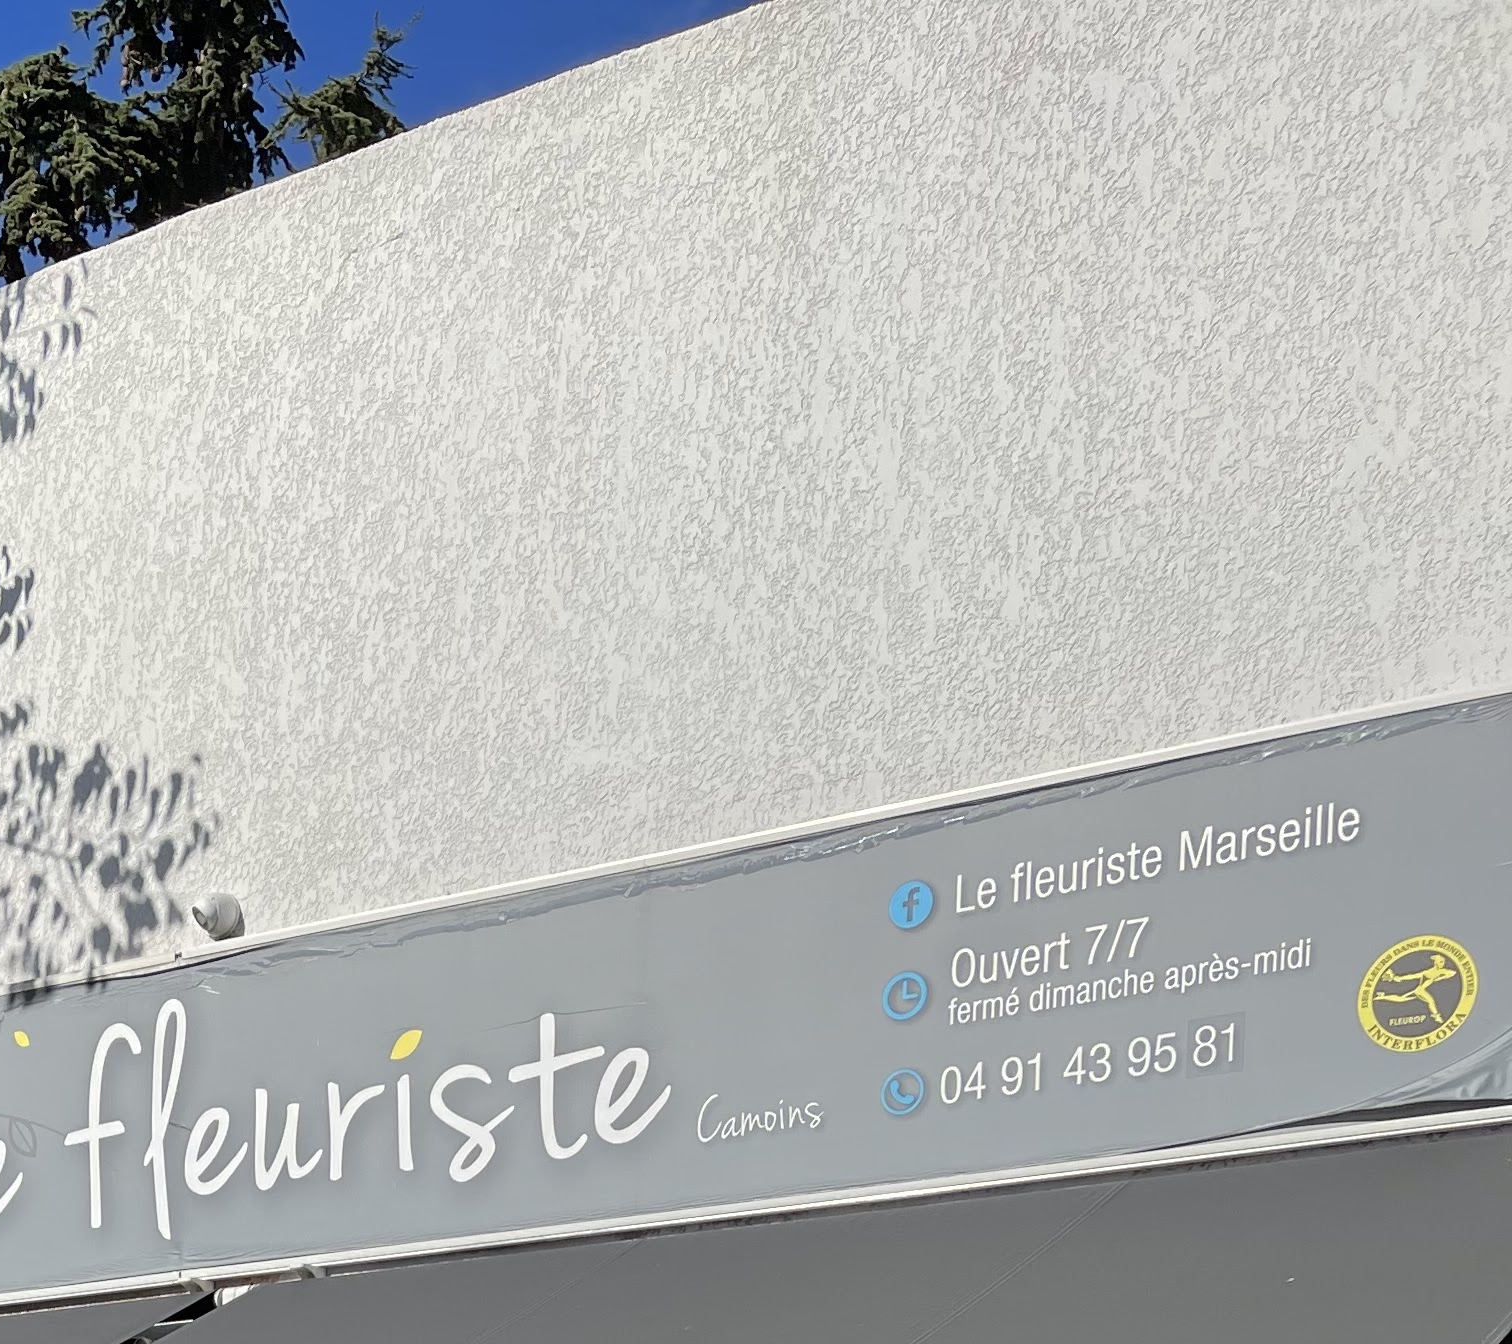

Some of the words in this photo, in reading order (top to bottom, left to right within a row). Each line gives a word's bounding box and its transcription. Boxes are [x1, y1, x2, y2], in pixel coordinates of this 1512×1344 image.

[954, 872, 997, 913] Le
[1011, 842, 1163, 900] fleuriste
[1179, 802, 1361, 872] Marseille
[948, 984, 1020, 1026] fermé
[1028, 966, 1156, 1012] dimanche
[1164, 938, 1314, 995] après-midi
[951, 932, 1070, 989] Ouvert
[1087, 916, 1151, 966] 7/7
[1361, 989, 1369, 1008] DES
[1365, 954, 1393, 989] FLEURS
[1393, 940, 1420, 957] DANS
[1422, 939, 1435, 947] LE
[1436, 940, 1467, 963] MONDE
[1462, 961, 1475, 996] ENTIER
[1368, 1012, 1467, 1050] INTERFLORA
[1389, 1015, 1426, 1026] FLEUROP
[939, 1063, 987, 1105] 04
[1000, 1053, 1044, 1095] 91
[1063, 1044, 1113, 1086] 43
[1127, 1032, 1177, 1076] 95
[1192, 1022, 1238, 1069] 81
[64, 998, 672, 1241] fleuriste
[696, 1093, 825, 1145] Camoins
